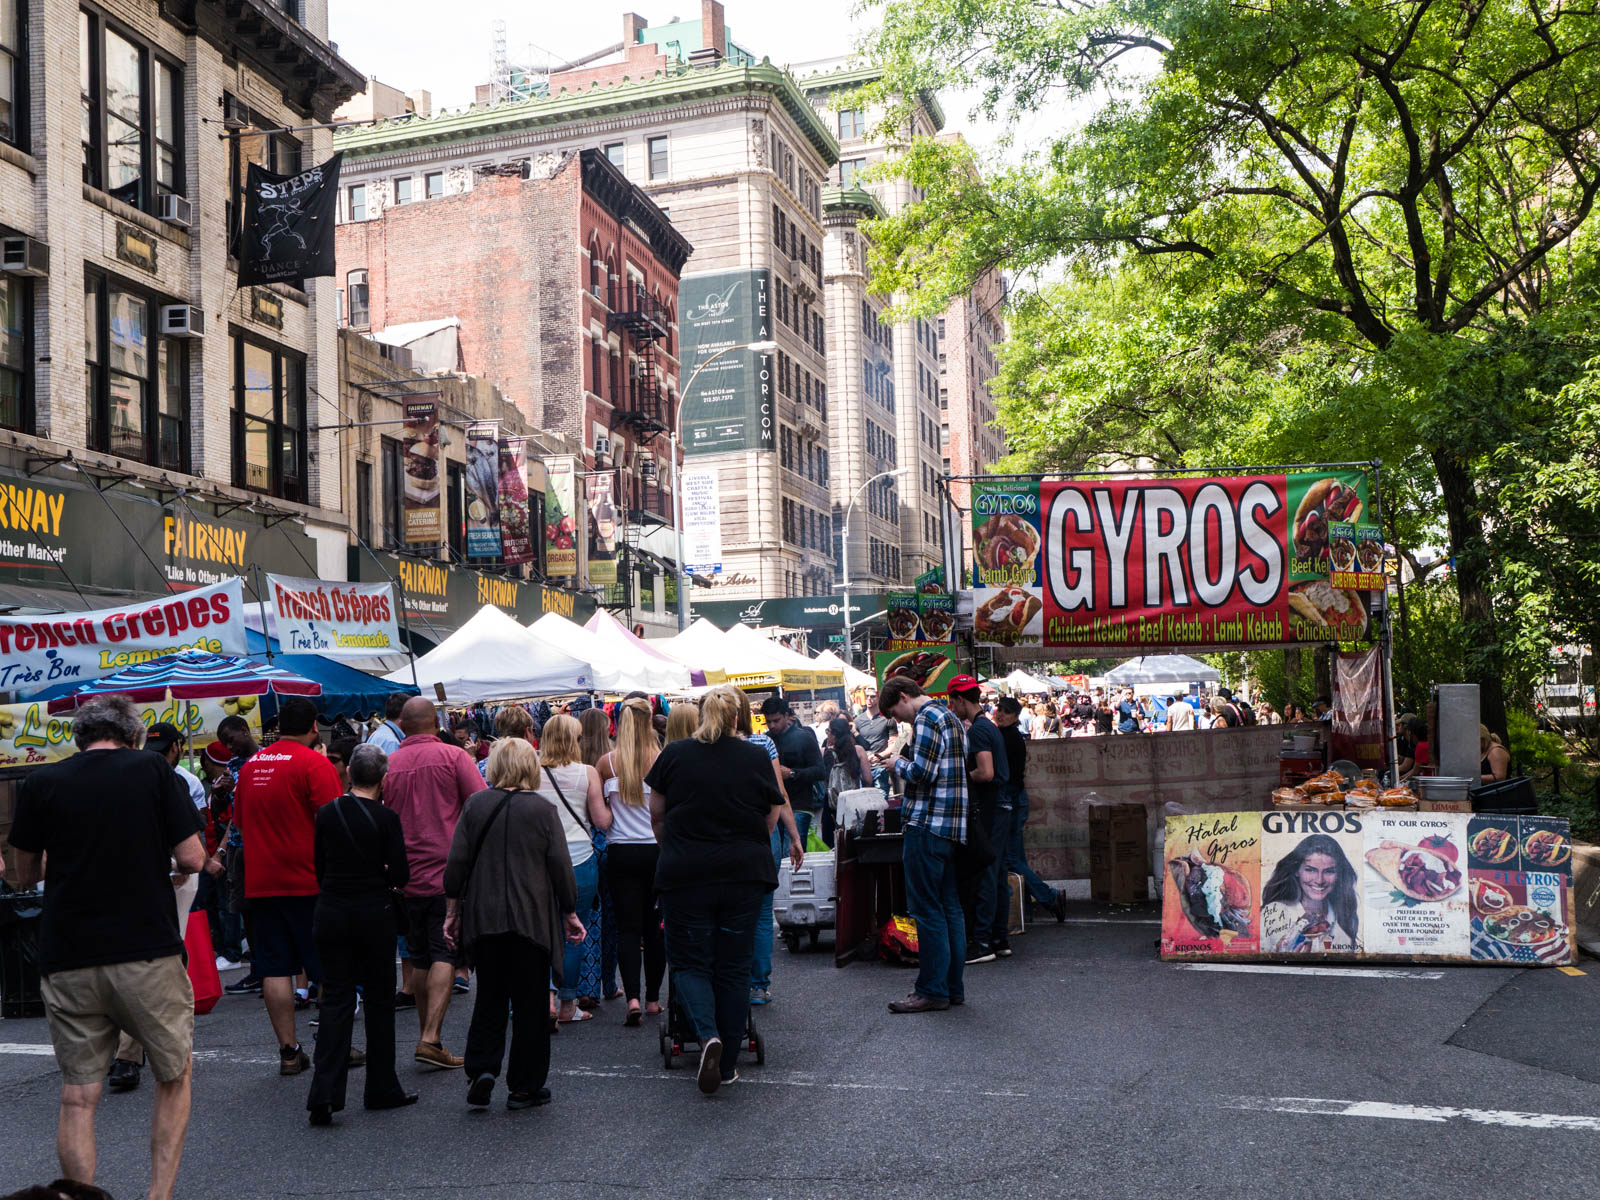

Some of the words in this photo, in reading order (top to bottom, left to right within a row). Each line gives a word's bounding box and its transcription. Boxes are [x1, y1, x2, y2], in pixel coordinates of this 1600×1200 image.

[260, 167, 324, 199] STEPS
[261, 261, 301, 273] DANCE
[975, 494, 1037, 514] GYROS
[408, 518, 438, 526] CATERING
[164, 516, 247, 566] FAIRWAY
[1045, 480, 1285, 611] GYROS
[547, 553, 576, 562] ORGANICS
[1291, 557, 1312, 574] Beef
[186, 568, 197, 582] No
[198, 570, 219, 585] Other
[400, 561, 448, 597] FAIRWAY
[720, 572, 757, 586] Astor
[978, 564, 1008, 584] Lamb
[1011, 563, 1037, 587] Gyro
[1331, 573, 1344, 588] LAMB
[1344, 573, 1357, 588] GYROS
[1358, 574, 1370, 589] BEEF
[1370, 574, 1385, 590] GYROS
[478, 577, 519, 609] FAIRWAY
[275, 582, 331, 622] French
[331, 586, 390, 626] Crêpes
[419, 600, 431, 611] Other
[542, 589, 575, 618] FAIRWAY
[921, 599, 954, 609] GYROS
[1049, 615, 1090, 643] Chicken
[1093, 613, 1128, 643] Kebab
[1138, 611, 1164, 643] Beef
[1167, 611, 1202, 643] Kebab
[1213, 611, 1243, 642] Lamb
[1247, 610, 1283, 642] Kebab
[1296, 620, 1338, 641] Chicken
[1340, 620, 1364, 642] Gyro
[290, 630, 312, 649] Très
[313, 631, 329, 650] Bon
[332, 629, 390, 648] Lemonade
[979, 631, 1006, 643] Beef
[1010, 631, 1039, 646] Gyro
[1, 663, 43, 687] Très
[47, 657, 81, 680] Bon
[25, 750, 47, 763] Bon
[1185, 815, 1238, 844] Halal
[1262, 812, 1362, 834] GYROS
[1382, 819, 1397, 827] TRY
[1420, 820, 1448, 828] GYROS
[1207, 837, 1258, 864] Gyros
[1516, 873, 1560, 887] GYROS
[1264, 903, 1278, 917] Ask
[1264, 916, 1276, 927] For
[1280, 910, 1285, 921] A
[1266, 917, 1292, 938] Kronos!
[1175, 943, 1212, 952] KRONOS
